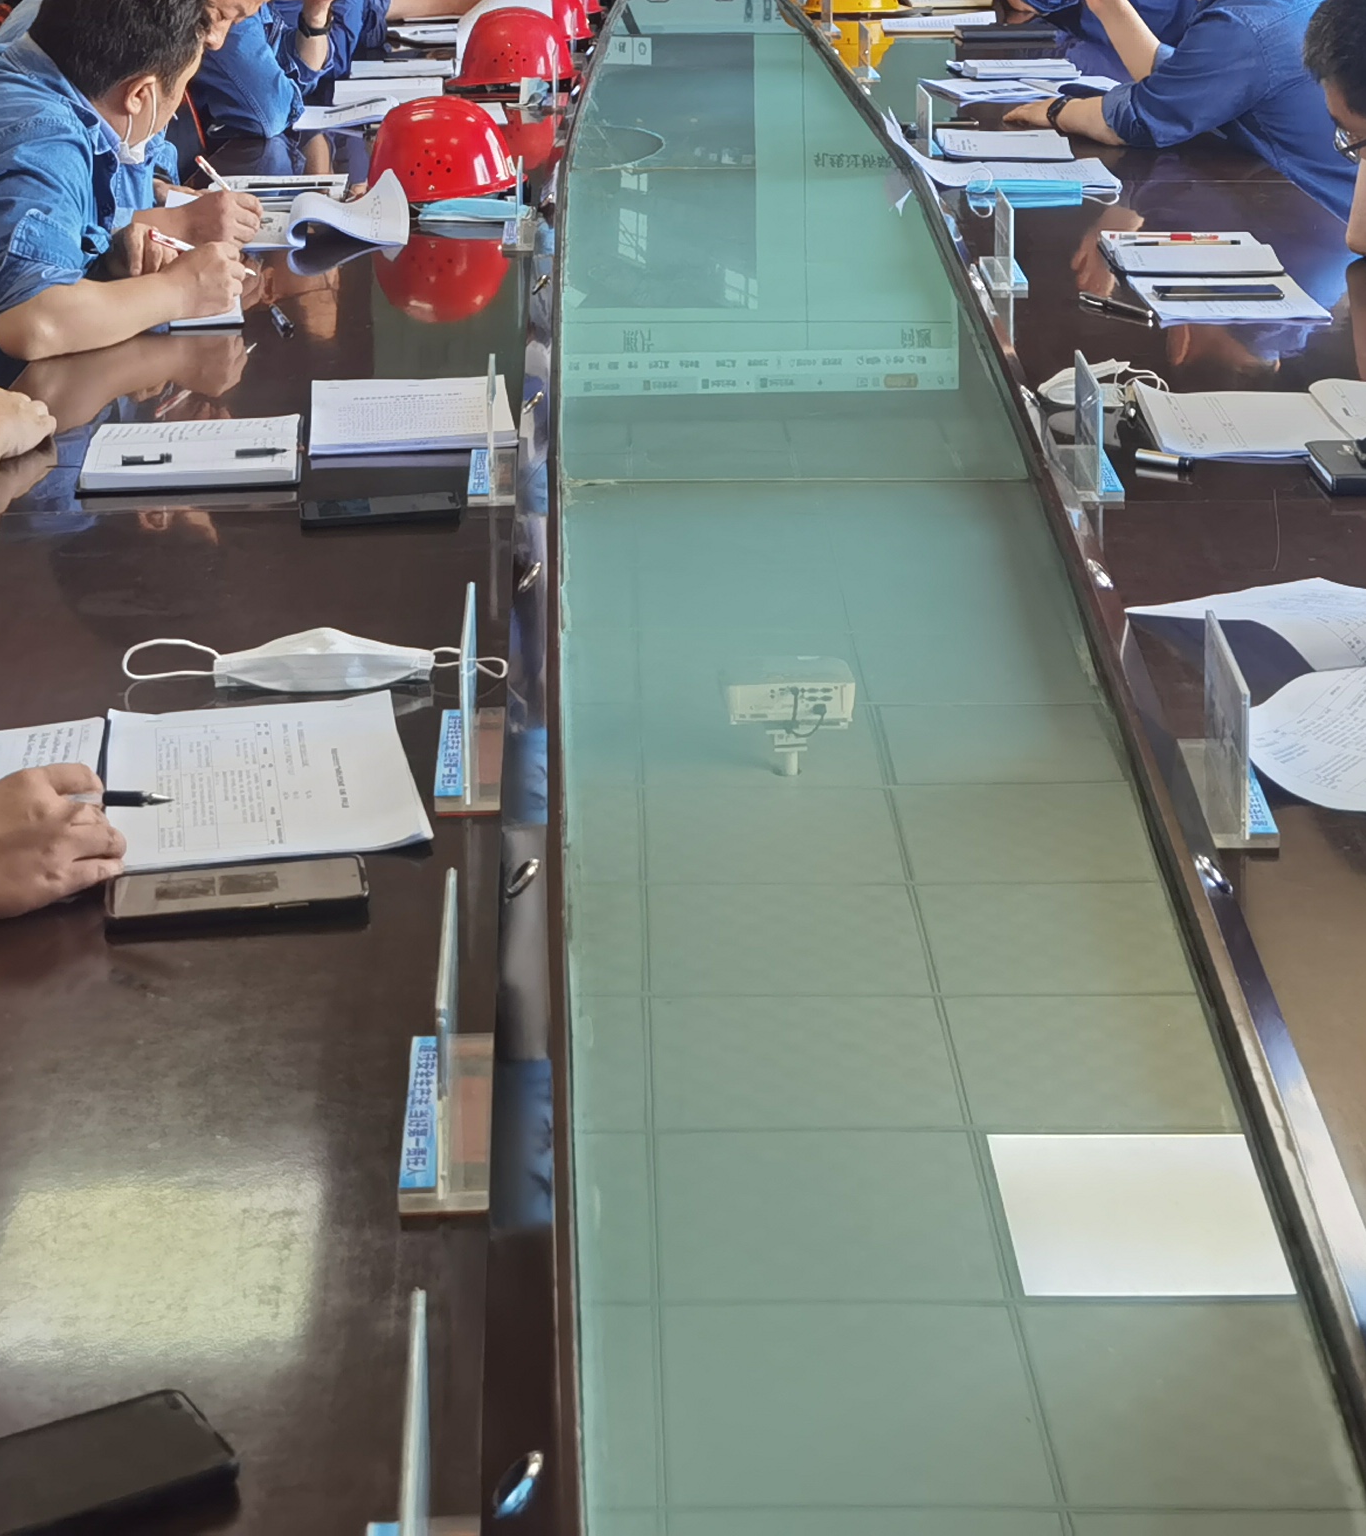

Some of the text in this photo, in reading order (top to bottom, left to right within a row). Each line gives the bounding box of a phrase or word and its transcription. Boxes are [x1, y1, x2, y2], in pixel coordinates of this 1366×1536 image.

[405, 1109, 430, 1177] 当好第一责任人
